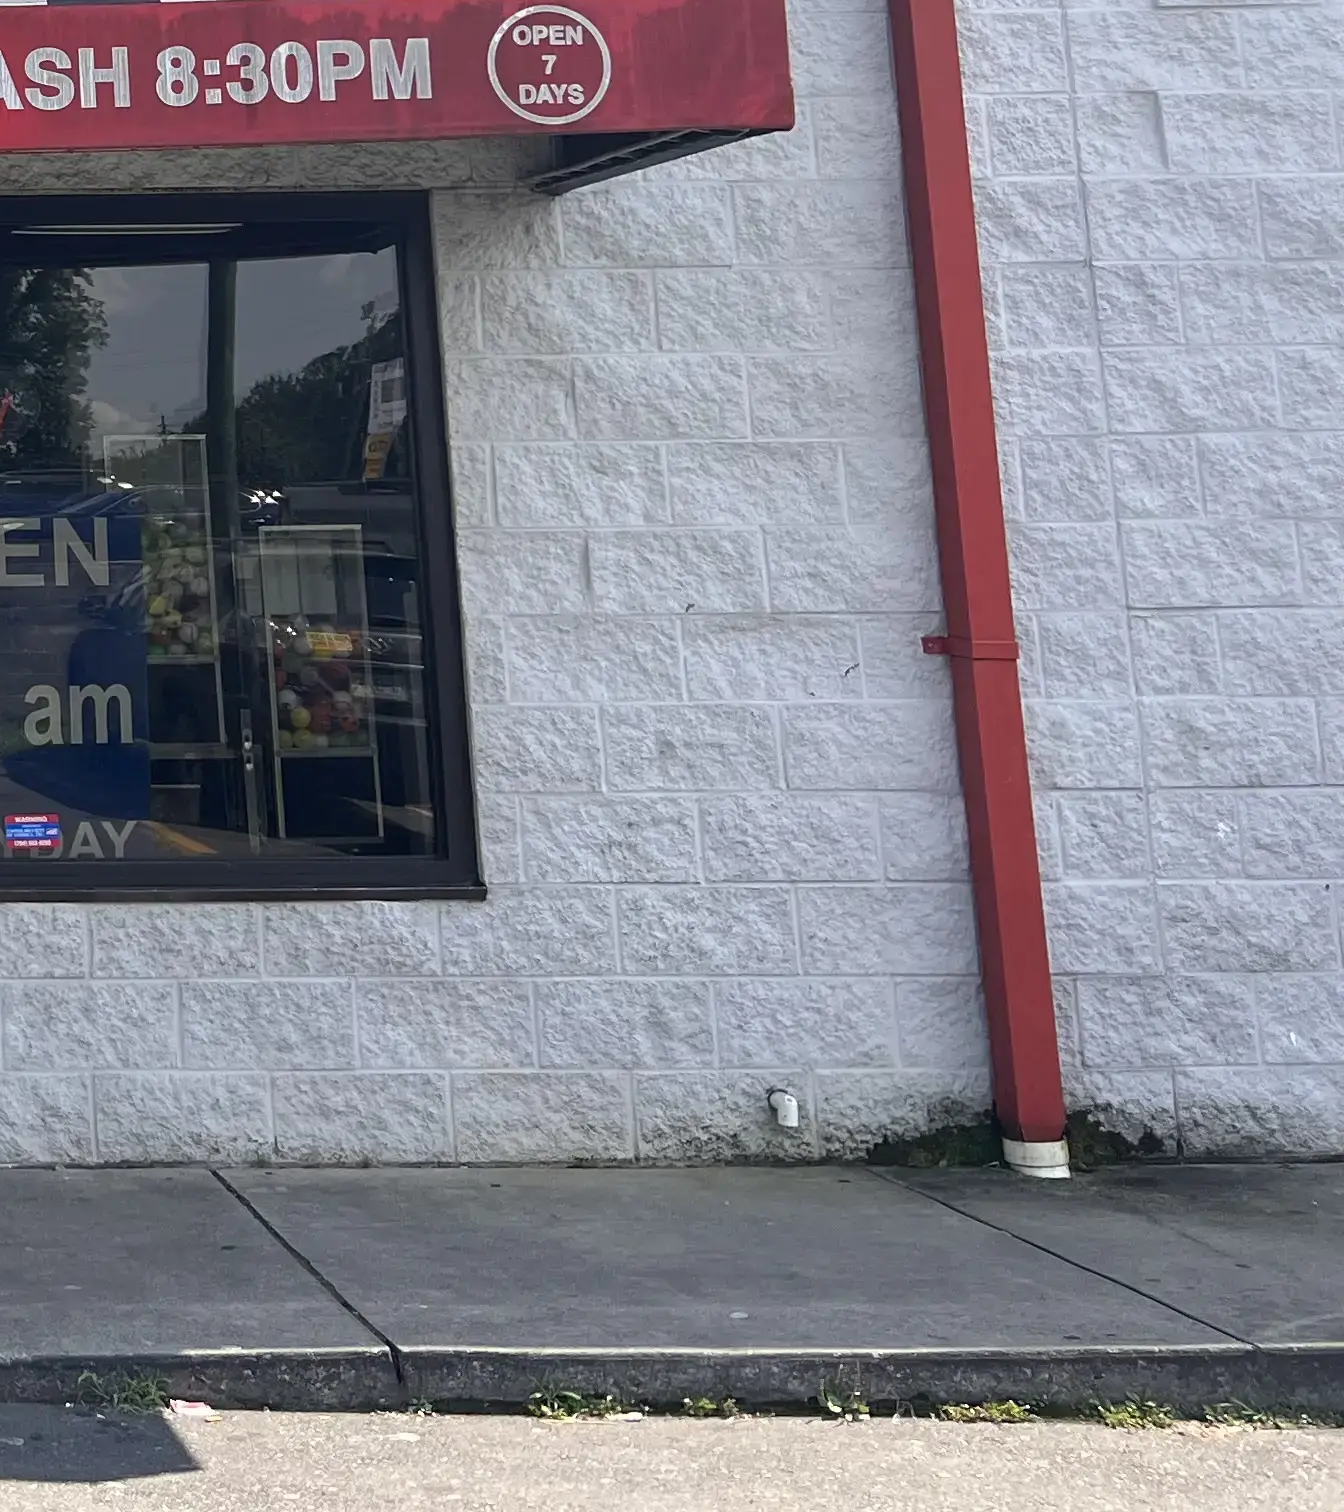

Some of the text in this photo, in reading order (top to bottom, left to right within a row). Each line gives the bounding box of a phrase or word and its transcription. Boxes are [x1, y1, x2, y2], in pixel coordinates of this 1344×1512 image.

[512, 25, 584, 47] OPEN
[155, 37, 434, 108] 8:30PM
[541, 54, 556, 75] 7
[517, 83, 585, 105] DAYS
[23, 684, 133, 745] am
